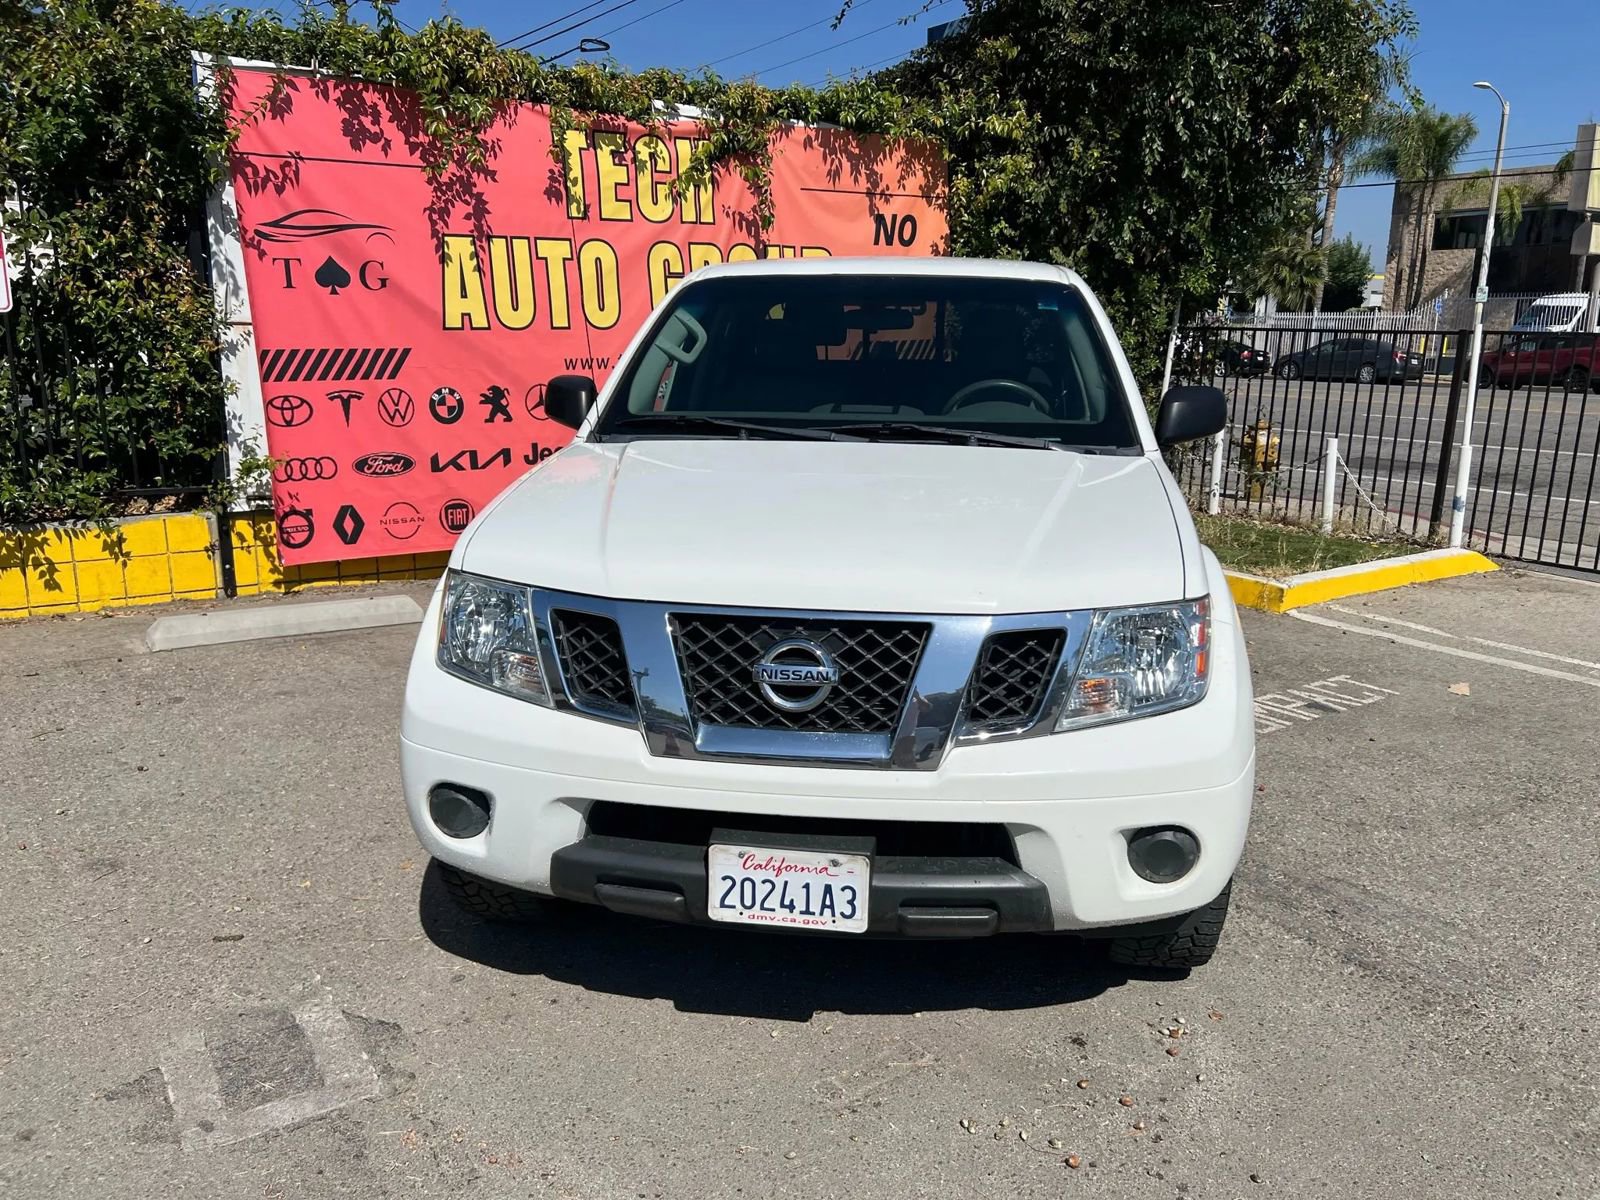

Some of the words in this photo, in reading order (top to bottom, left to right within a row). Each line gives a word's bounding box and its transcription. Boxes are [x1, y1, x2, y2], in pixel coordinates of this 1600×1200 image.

[552, 128, 716, 225] TECH
[873, 213, 918, 247] NO
[442, 233, 621, 330] AUTO
[431, 387, 460, 401] BMW
[523, 442, 564, 465] Je
[364, 456, 405, 473] Ford
[380, 516, 425, 525] NISSAN
[447, 508, 468, 526] FIAT
[760, 668, 830, 682] NISSAN
[742, 853, 839, 877] California
[719, 875, 857, 920] 20241A3
[747, 913, 828, 926] dmv.ca.gov
